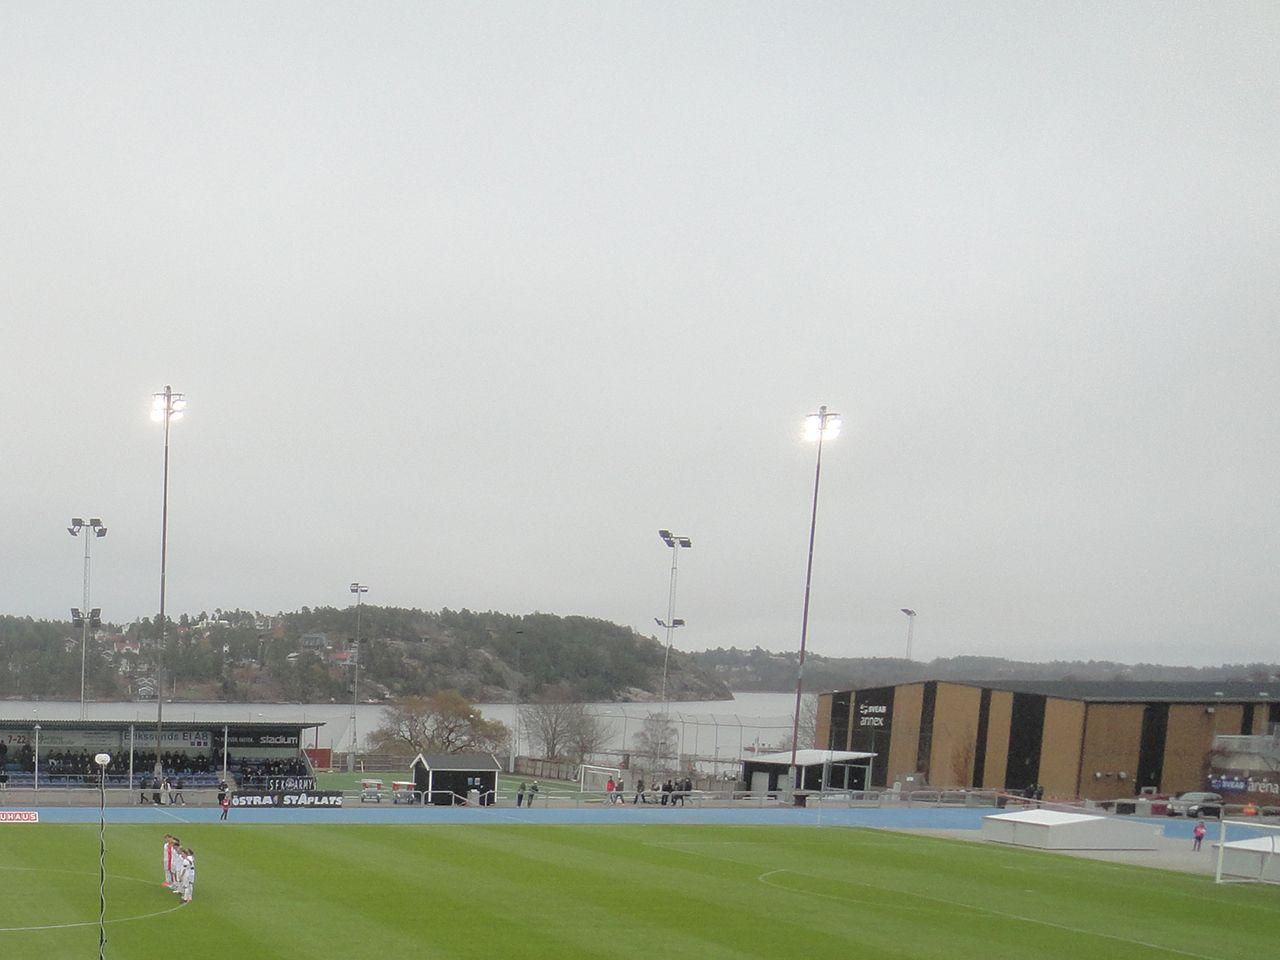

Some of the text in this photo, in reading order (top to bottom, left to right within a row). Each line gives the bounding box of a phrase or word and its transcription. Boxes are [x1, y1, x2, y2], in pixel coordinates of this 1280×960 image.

[860, 716, 883, 726] annex
[260, 735, 298, 744] stadium
[293, 779, 314, 790] ARMY
[1248, 781, 1279, 794] arena
